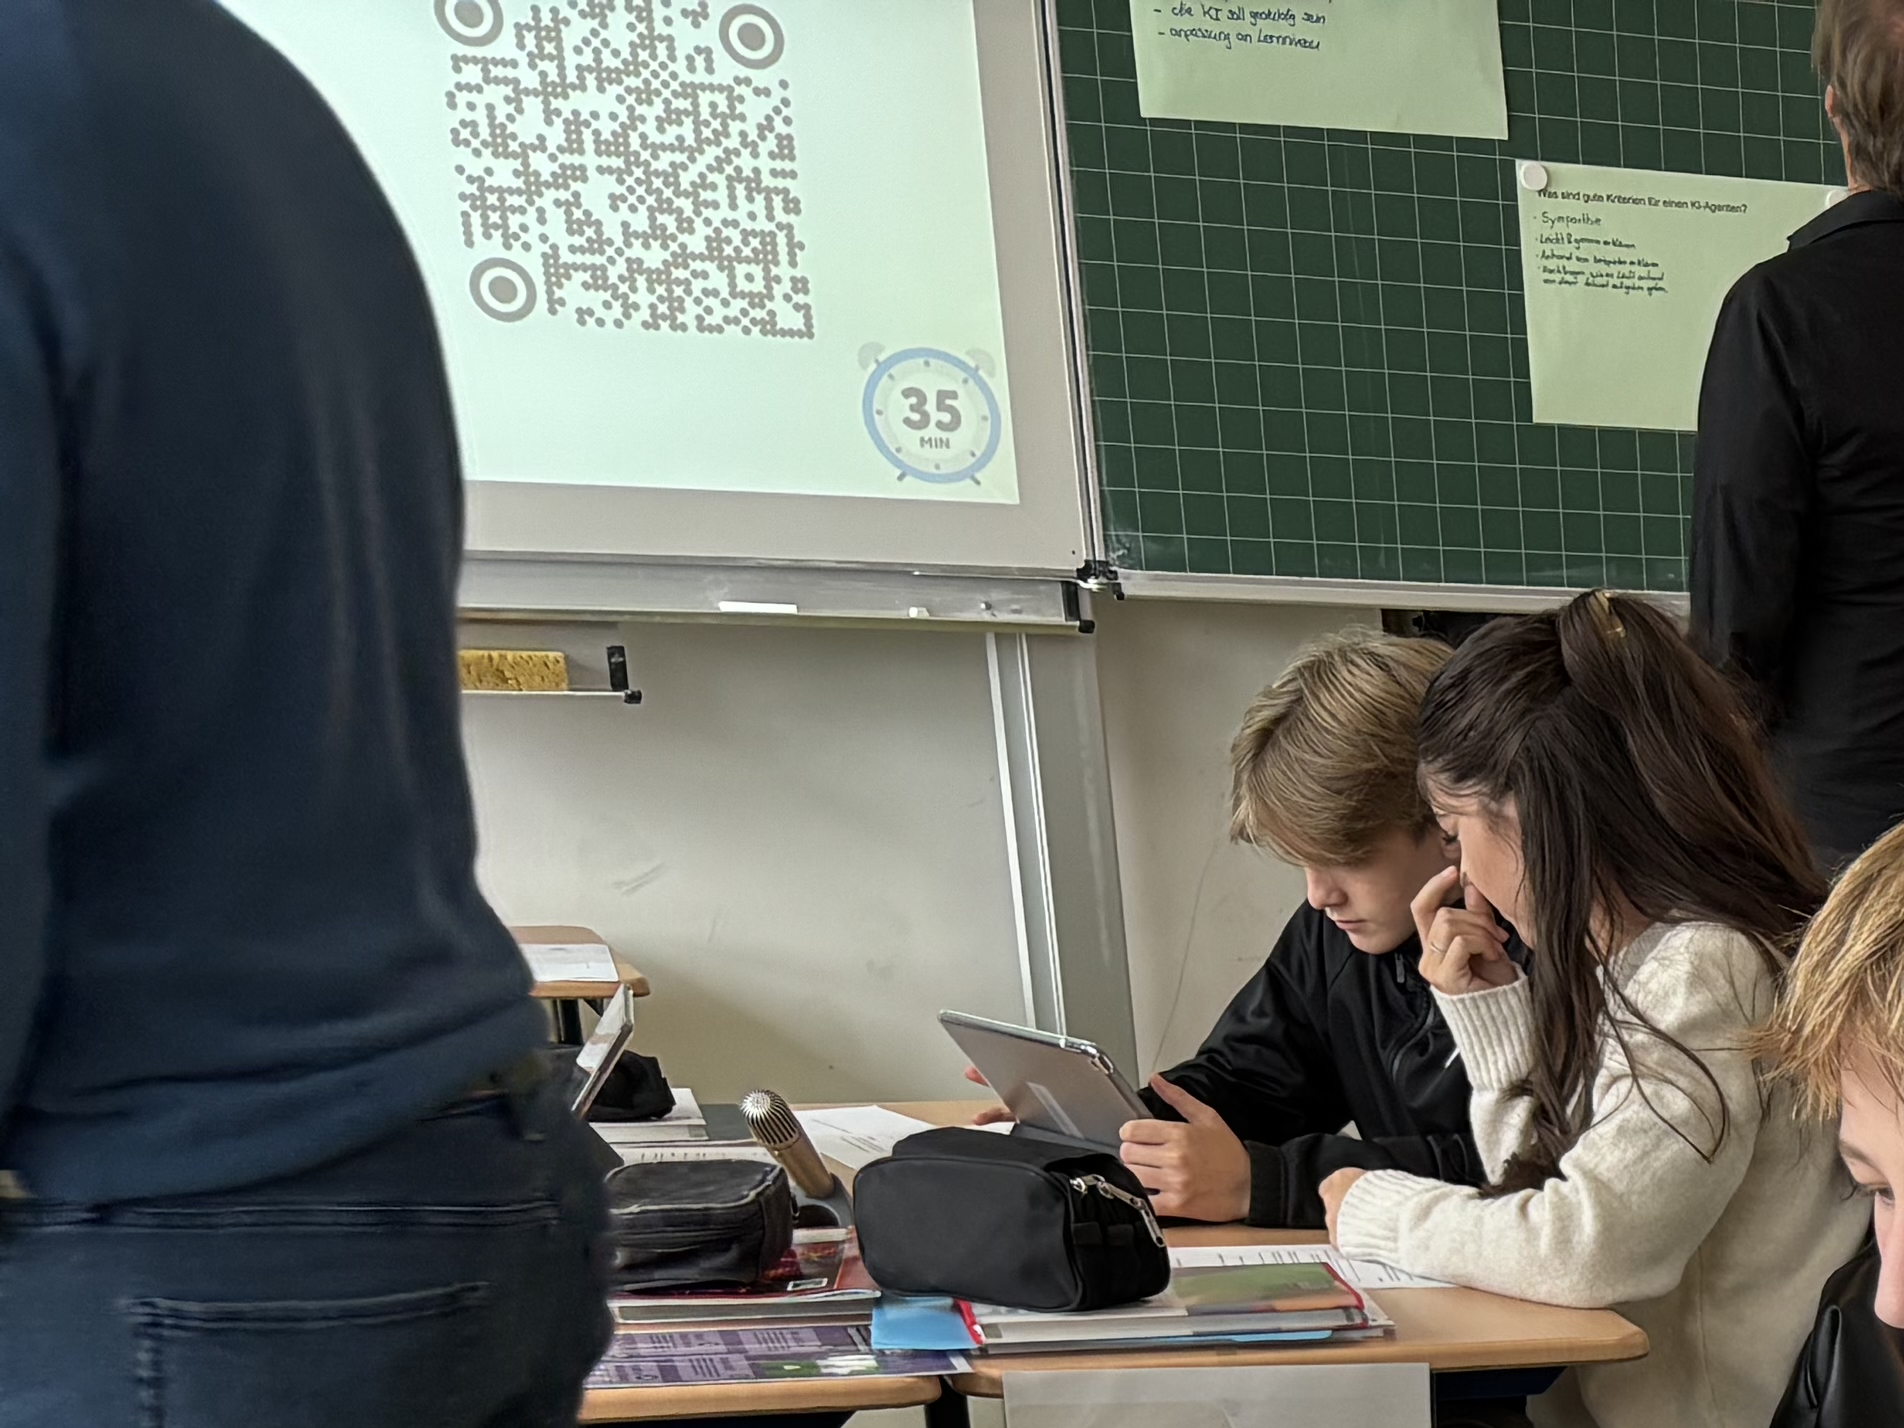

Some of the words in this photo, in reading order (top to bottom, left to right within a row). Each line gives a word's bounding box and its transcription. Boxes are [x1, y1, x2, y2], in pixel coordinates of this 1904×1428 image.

[1227, 7, 1245, 21] soll
[901, 387, 961, 432] 35
[920, 436, 950, 449] MIN
